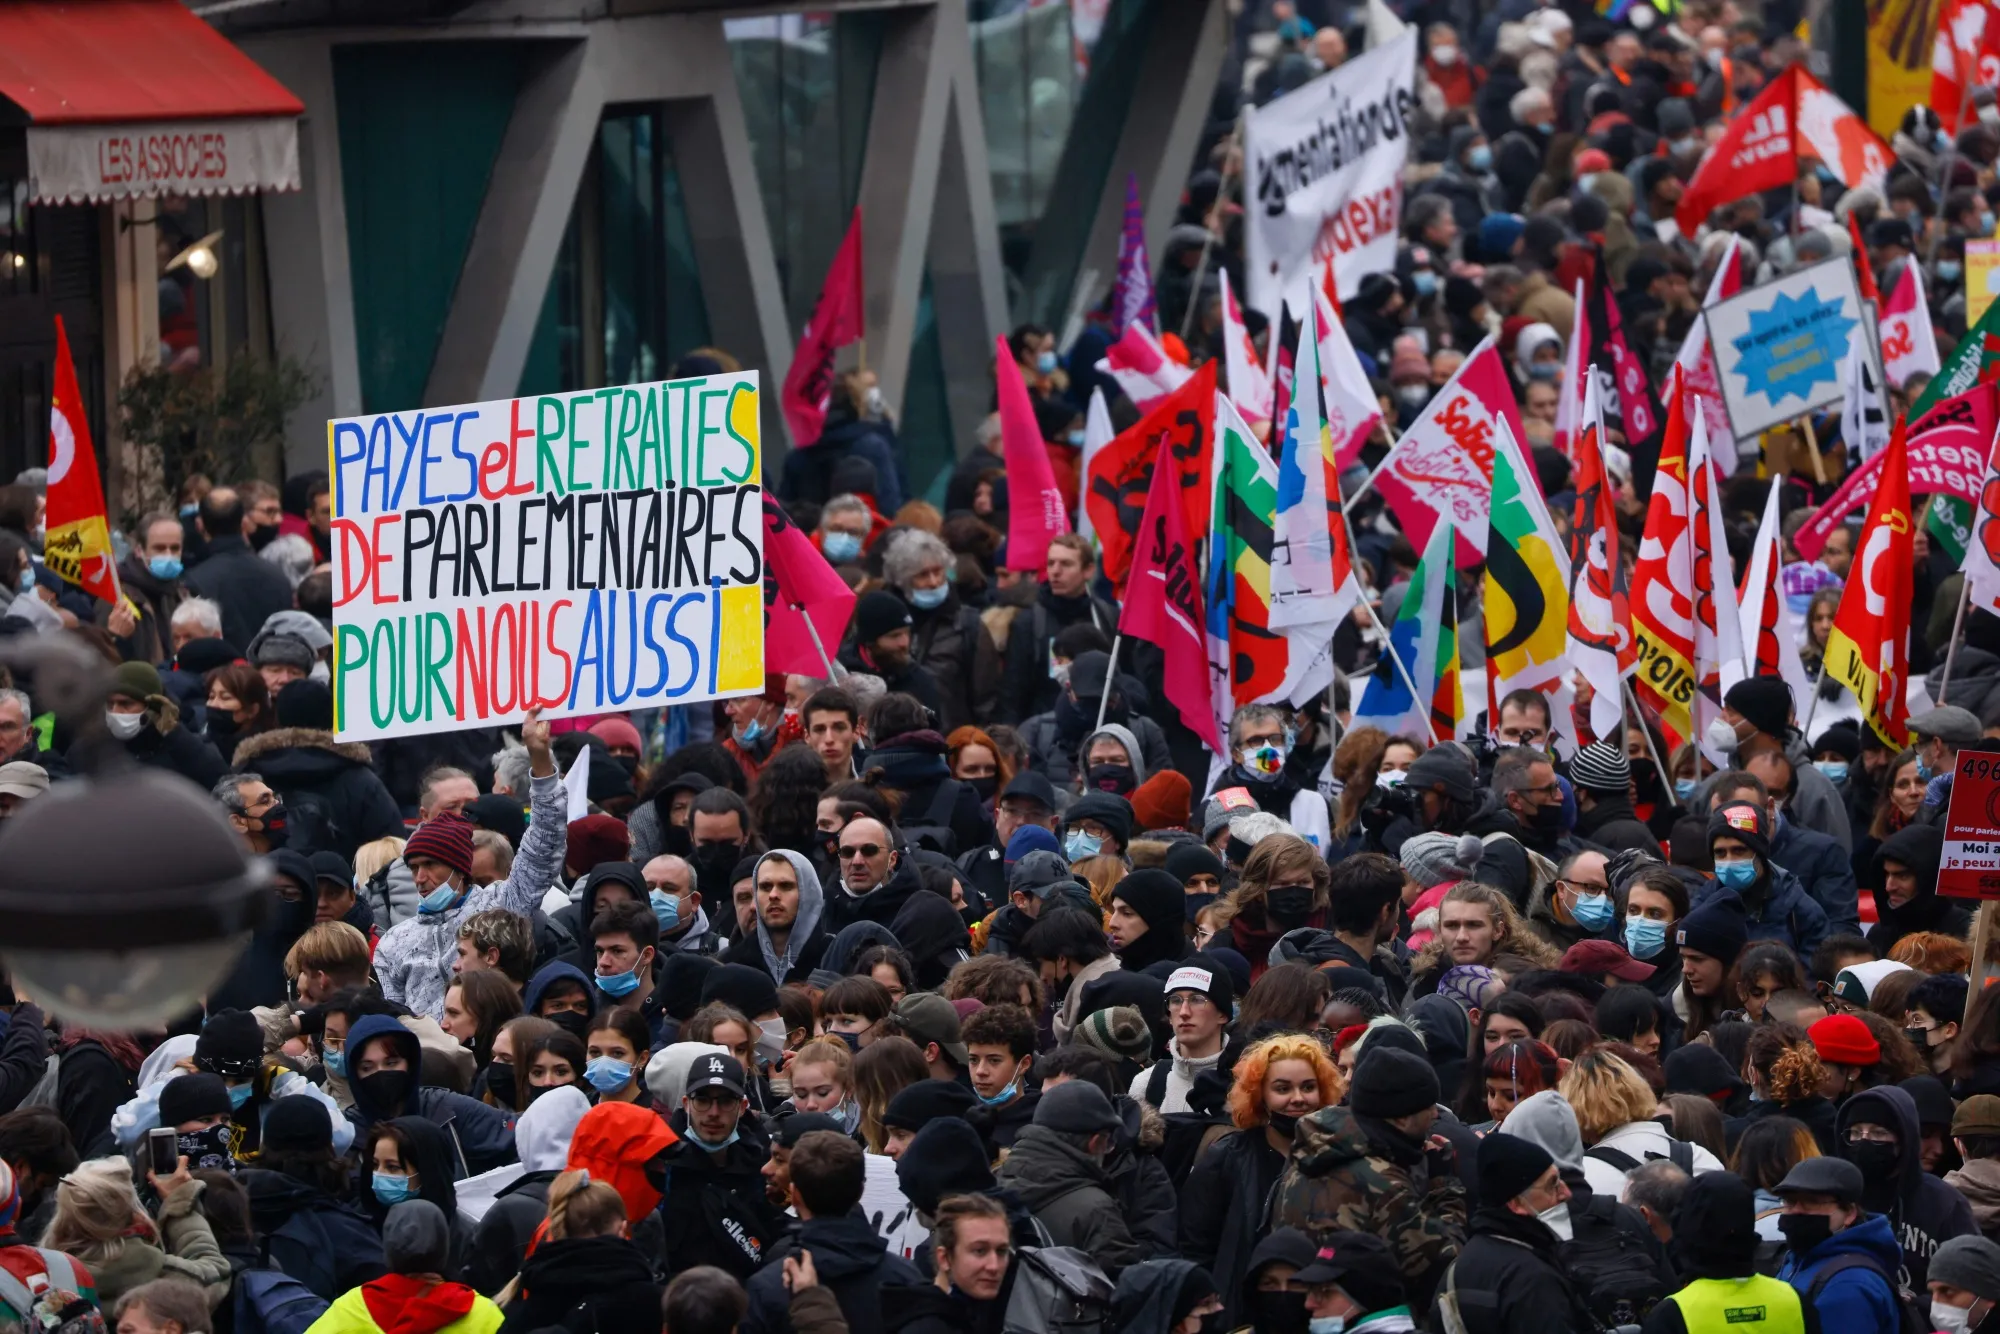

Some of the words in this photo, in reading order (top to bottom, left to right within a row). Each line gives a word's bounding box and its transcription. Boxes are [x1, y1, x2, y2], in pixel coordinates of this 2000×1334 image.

[99, 137, 133, 185] LES
[138, 133, 227, 182] ASSOCIES
[334, 410, 481, 516] PAYES
[478, 399, 535, 501] et
[332, 514, 402, 608] DE
[337, 610, 456, 733] POUR
[454, 599, 573, 722] NOUS
[1953, 824, 1975, 835] pour
[1946, 856, 1960, 869] je
[1962, 857, 1995, 869] peux
[1962, 841, 1989, 855] Moi
[708, 1056, 724, 1073] LA
